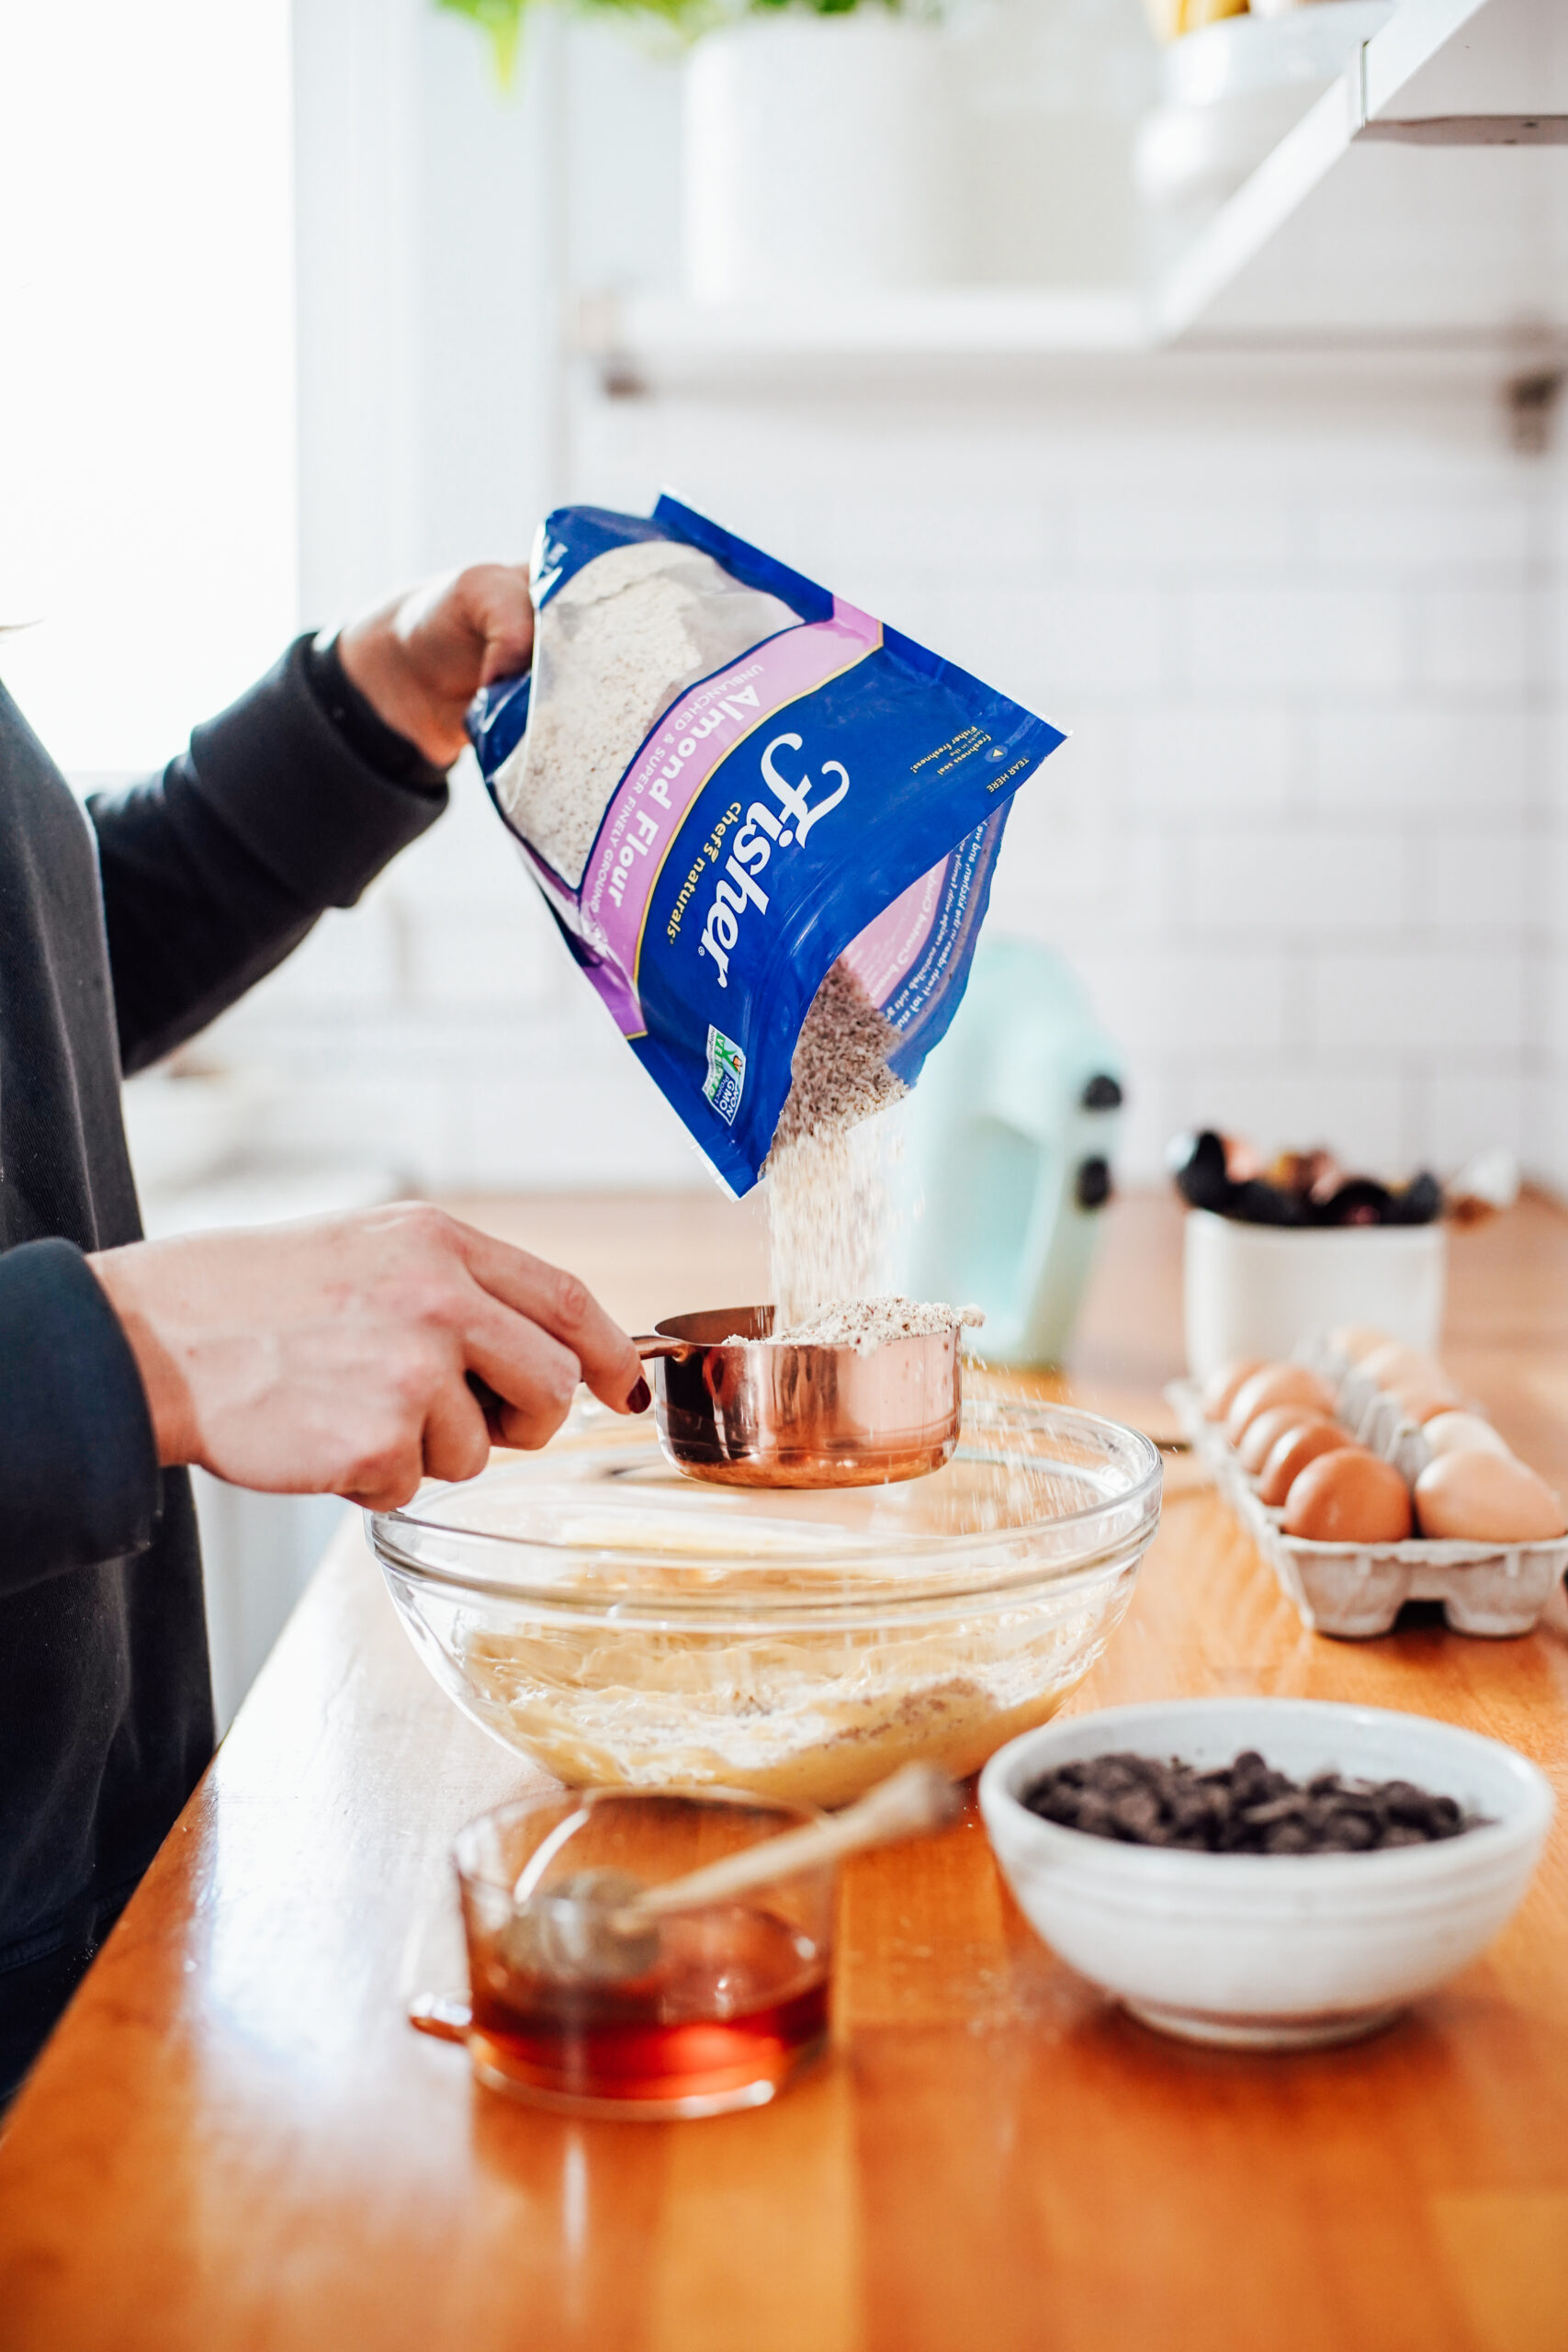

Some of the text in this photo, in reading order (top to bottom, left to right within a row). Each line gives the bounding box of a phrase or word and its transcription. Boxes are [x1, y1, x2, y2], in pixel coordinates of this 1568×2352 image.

[937, 734, 992, 775] freshness seal
[949, 747, 962, 757] the
[952, 726, 978, 745] Fisher
[591, 663, 765, 913] UNBLANCHED & SUPER FINELY GROUND
[986, 757, 1030, 793] TEAR HERE
[607, 684, 761, 908] Almond Flour
[701, 732, 850, 989] Fisher
[666, 857, 705, 939] naturals
[719, 1080, 735, 1111] GMO
[727, 1085, 739, 1117] NON
